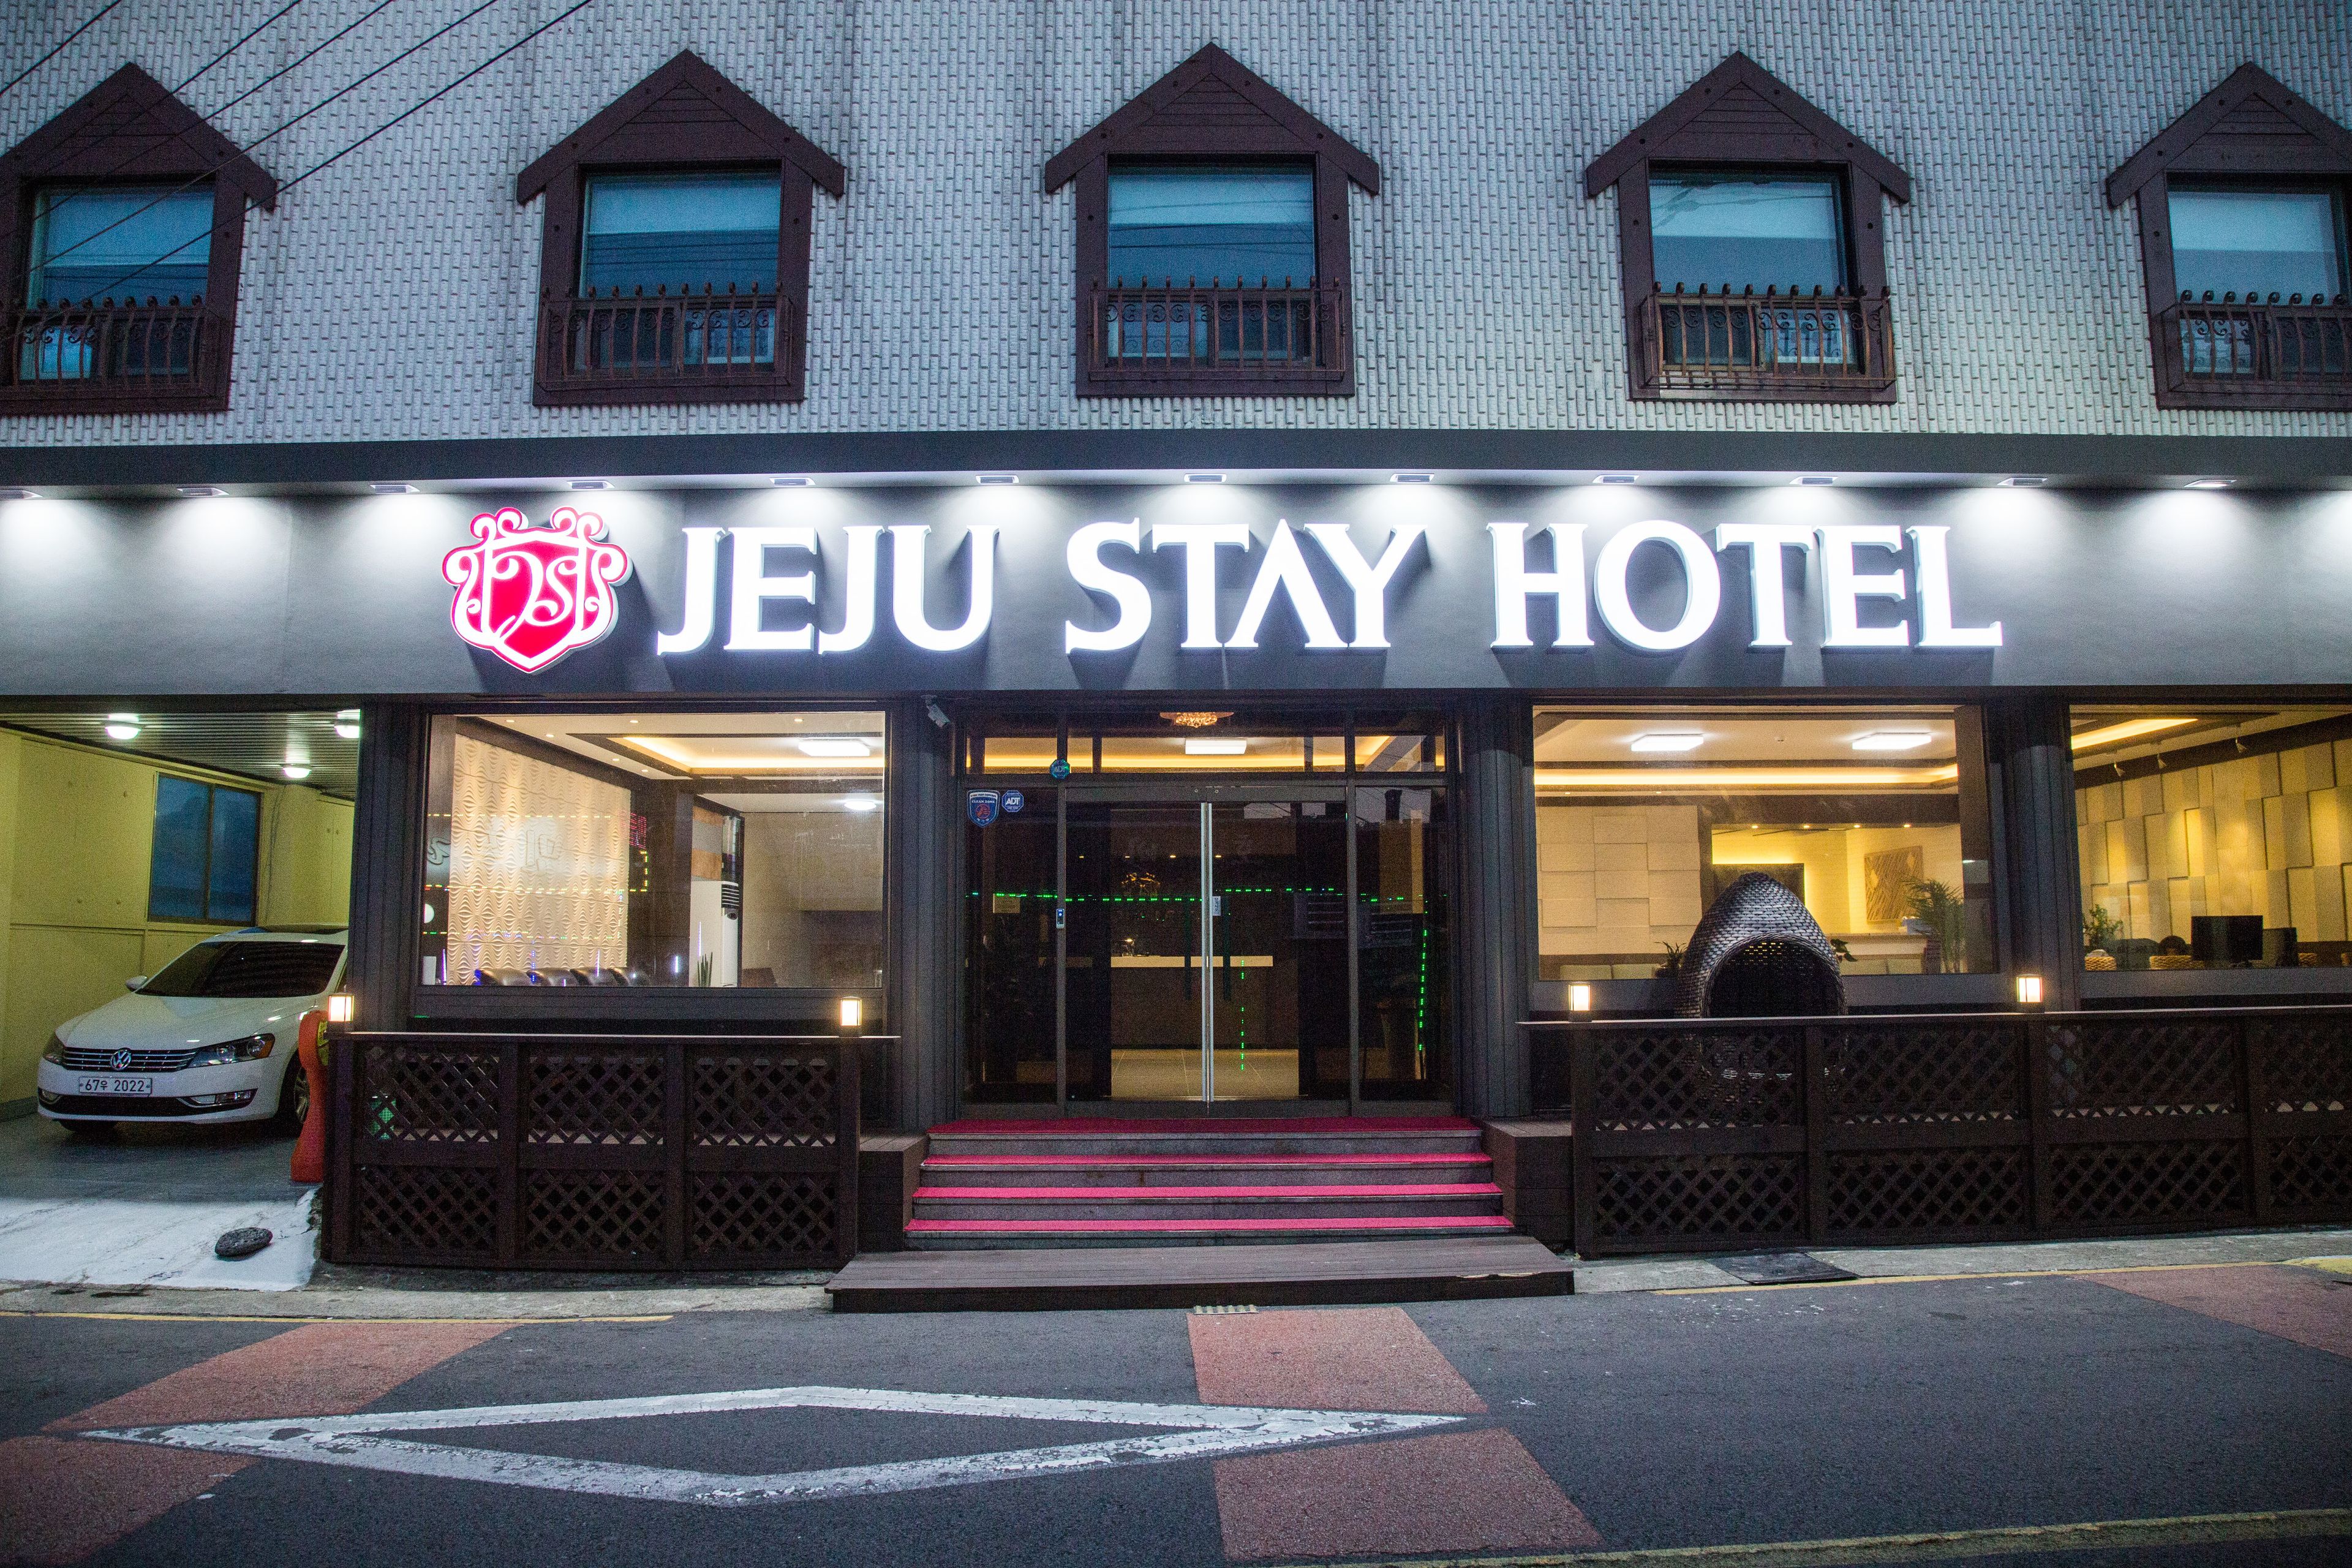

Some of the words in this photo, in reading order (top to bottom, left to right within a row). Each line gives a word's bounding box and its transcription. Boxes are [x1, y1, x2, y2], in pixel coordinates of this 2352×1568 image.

[657, 525, 1000, 655] JEJU
[1065, 518, 1428, 654] STAY
[1487, 520, 2003, 650] HOTEL
[85, 1079, 108, 1091] 67우
[114, 1080, 145, 1092] 2022
